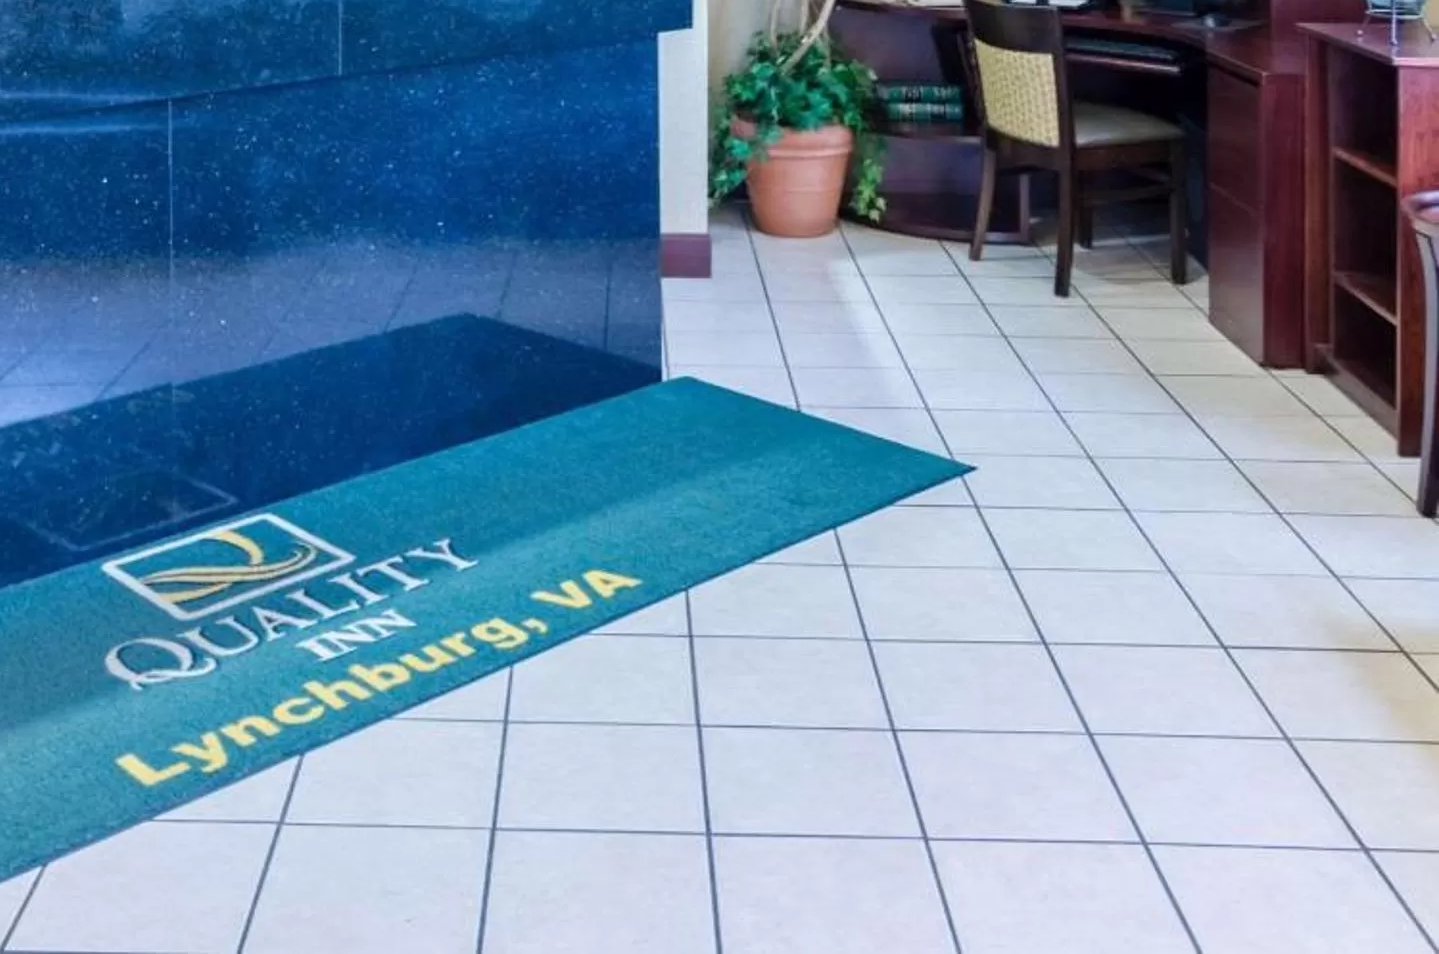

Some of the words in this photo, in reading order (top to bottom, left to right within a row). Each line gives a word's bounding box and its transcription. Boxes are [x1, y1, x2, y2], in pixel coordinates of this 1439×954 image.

[104, 537, 478, 691] QUALITY
[115, 616, 549, 787] Lynchburg,
[530, 569, 643, 610] VA
[296, 609, 417, 662] INN
